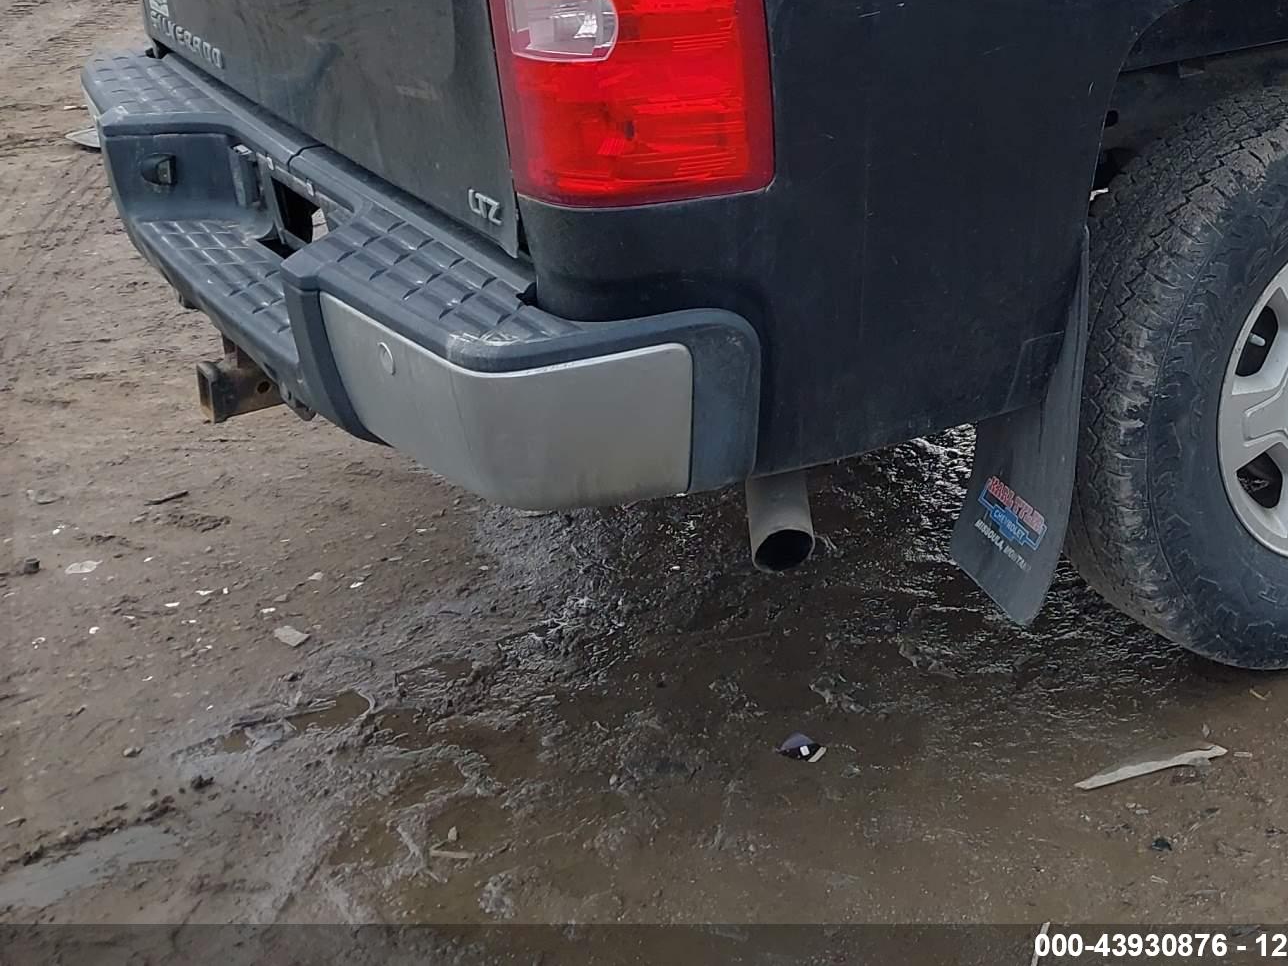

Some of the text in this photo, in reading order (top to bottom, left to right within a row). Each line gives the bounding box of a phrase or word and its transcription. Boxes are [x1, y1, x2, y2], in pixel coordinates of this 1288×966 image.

[150, 10, 223, 69] SILVERADO
[467, 188, 504, 226] LTZ
[993, 509, 1026, 541] CHEVROLET
